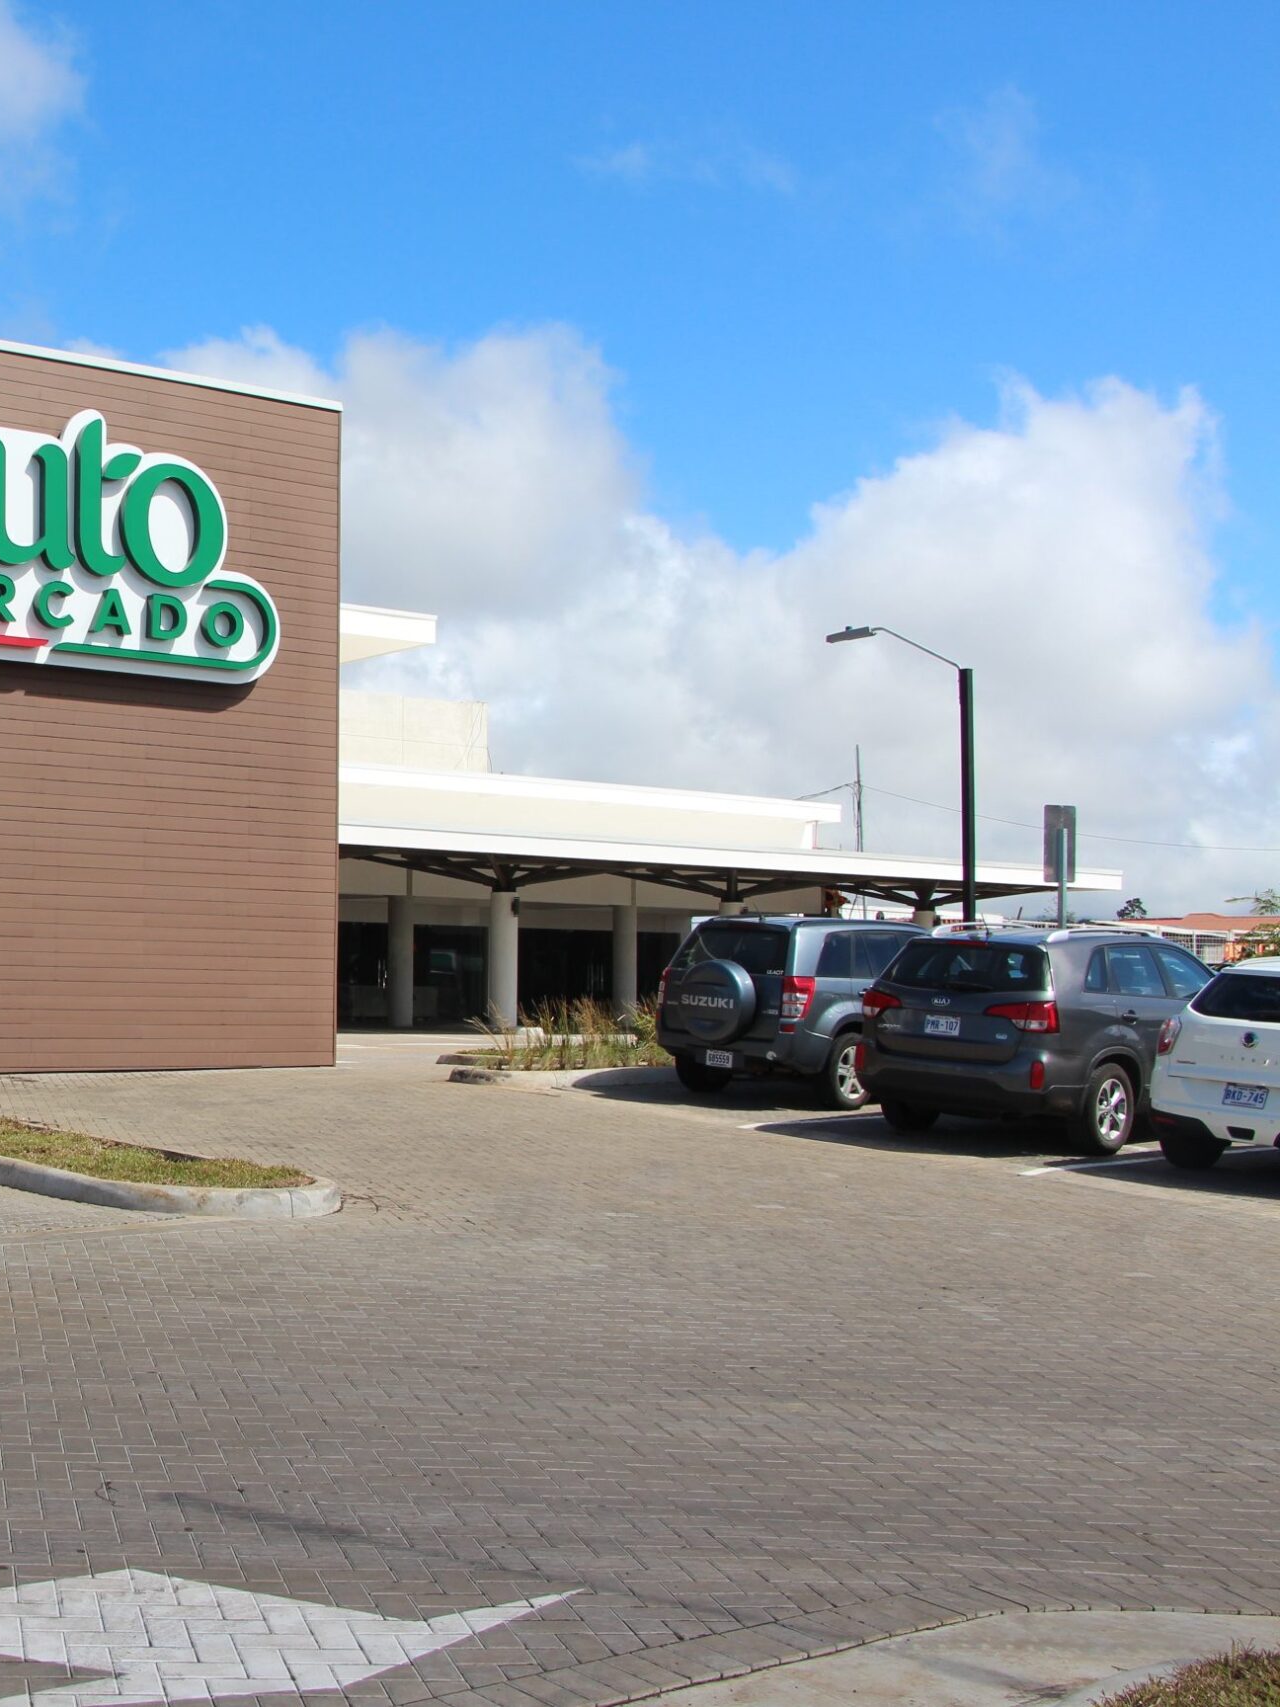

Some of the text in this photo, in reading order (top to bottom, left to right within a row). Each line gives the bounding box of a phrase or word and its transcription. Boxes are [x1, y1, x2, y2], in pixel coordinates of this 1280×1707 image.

[680, 993, 734, 1009] SUZUKI
[926, 1019, 959, 1032] PMR-107
[1225, 1088, 1265, 1104] BKD-745
